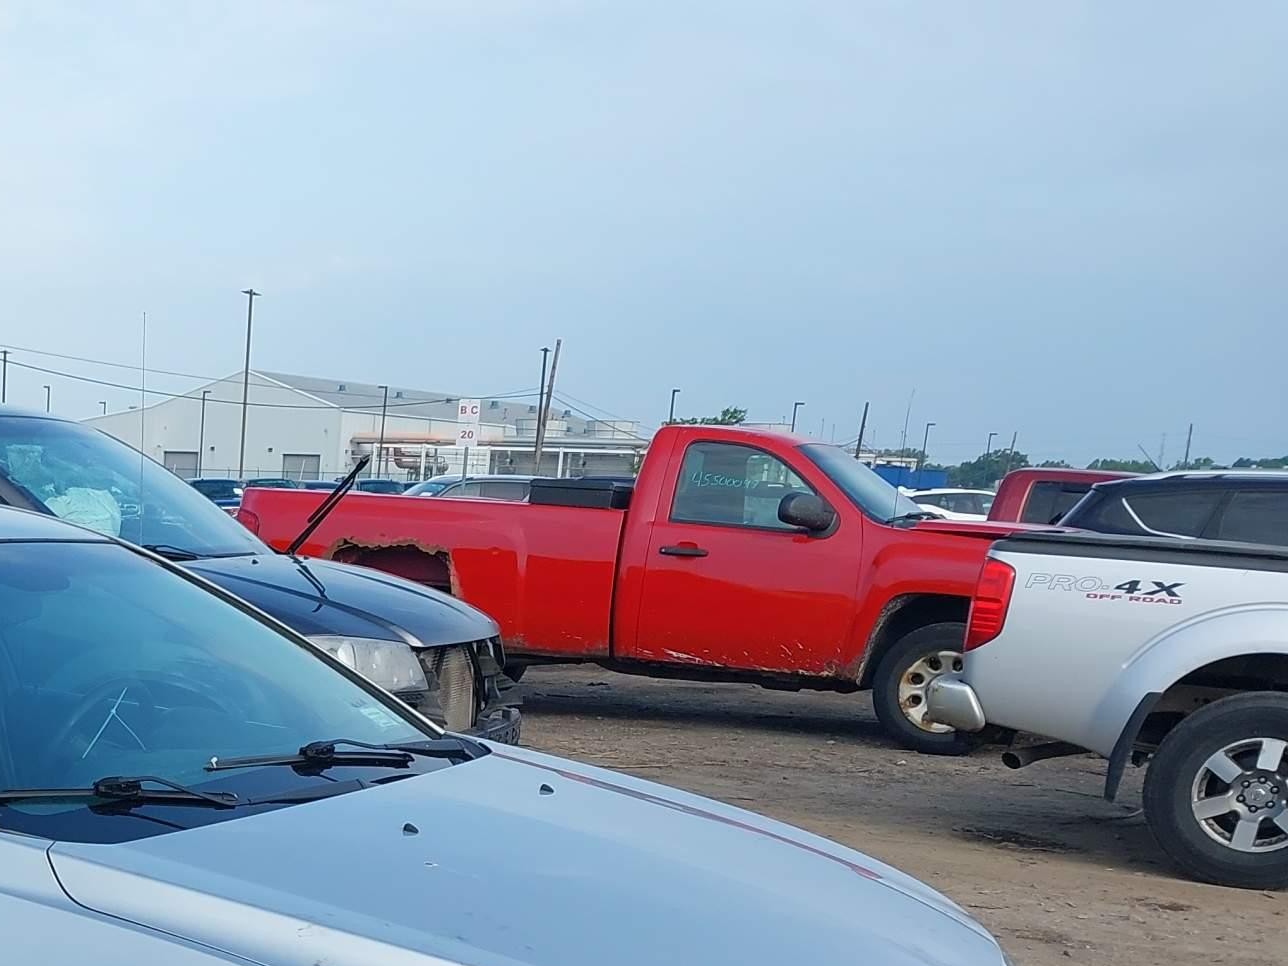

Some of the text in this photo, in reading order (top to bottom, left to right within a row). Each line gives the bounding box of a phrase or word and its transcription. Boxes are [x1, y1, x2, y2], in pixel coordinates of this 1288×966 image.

[460, 405, 479, 415] B C
[460, 430, 474, 439] 20
[1085, 593, 1183, 605] OFF ROAD
